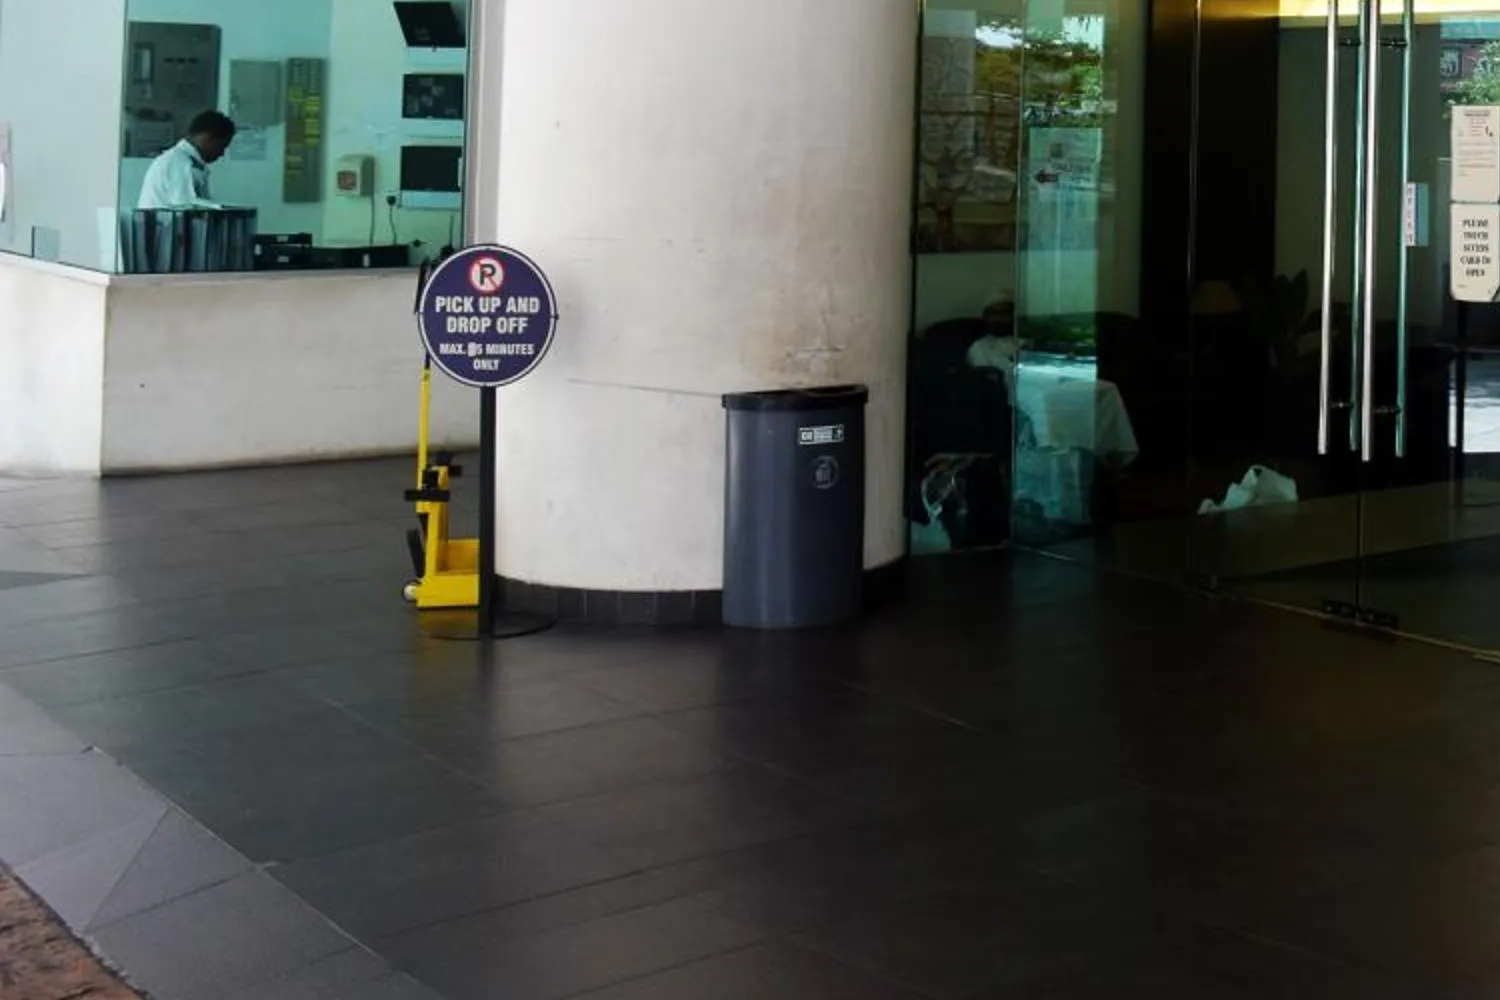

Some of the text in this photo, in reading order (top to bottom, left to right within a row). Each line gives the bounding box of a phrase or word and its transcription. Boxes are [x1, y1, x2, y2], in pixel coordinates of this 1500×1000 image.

[435, 296, 541, 313] PICK UP AND
[446, 316, 529, 334] DROP OFF
[485, 343, 534, 355] MINUTES
[473, 359, 500, 371] ONLY
